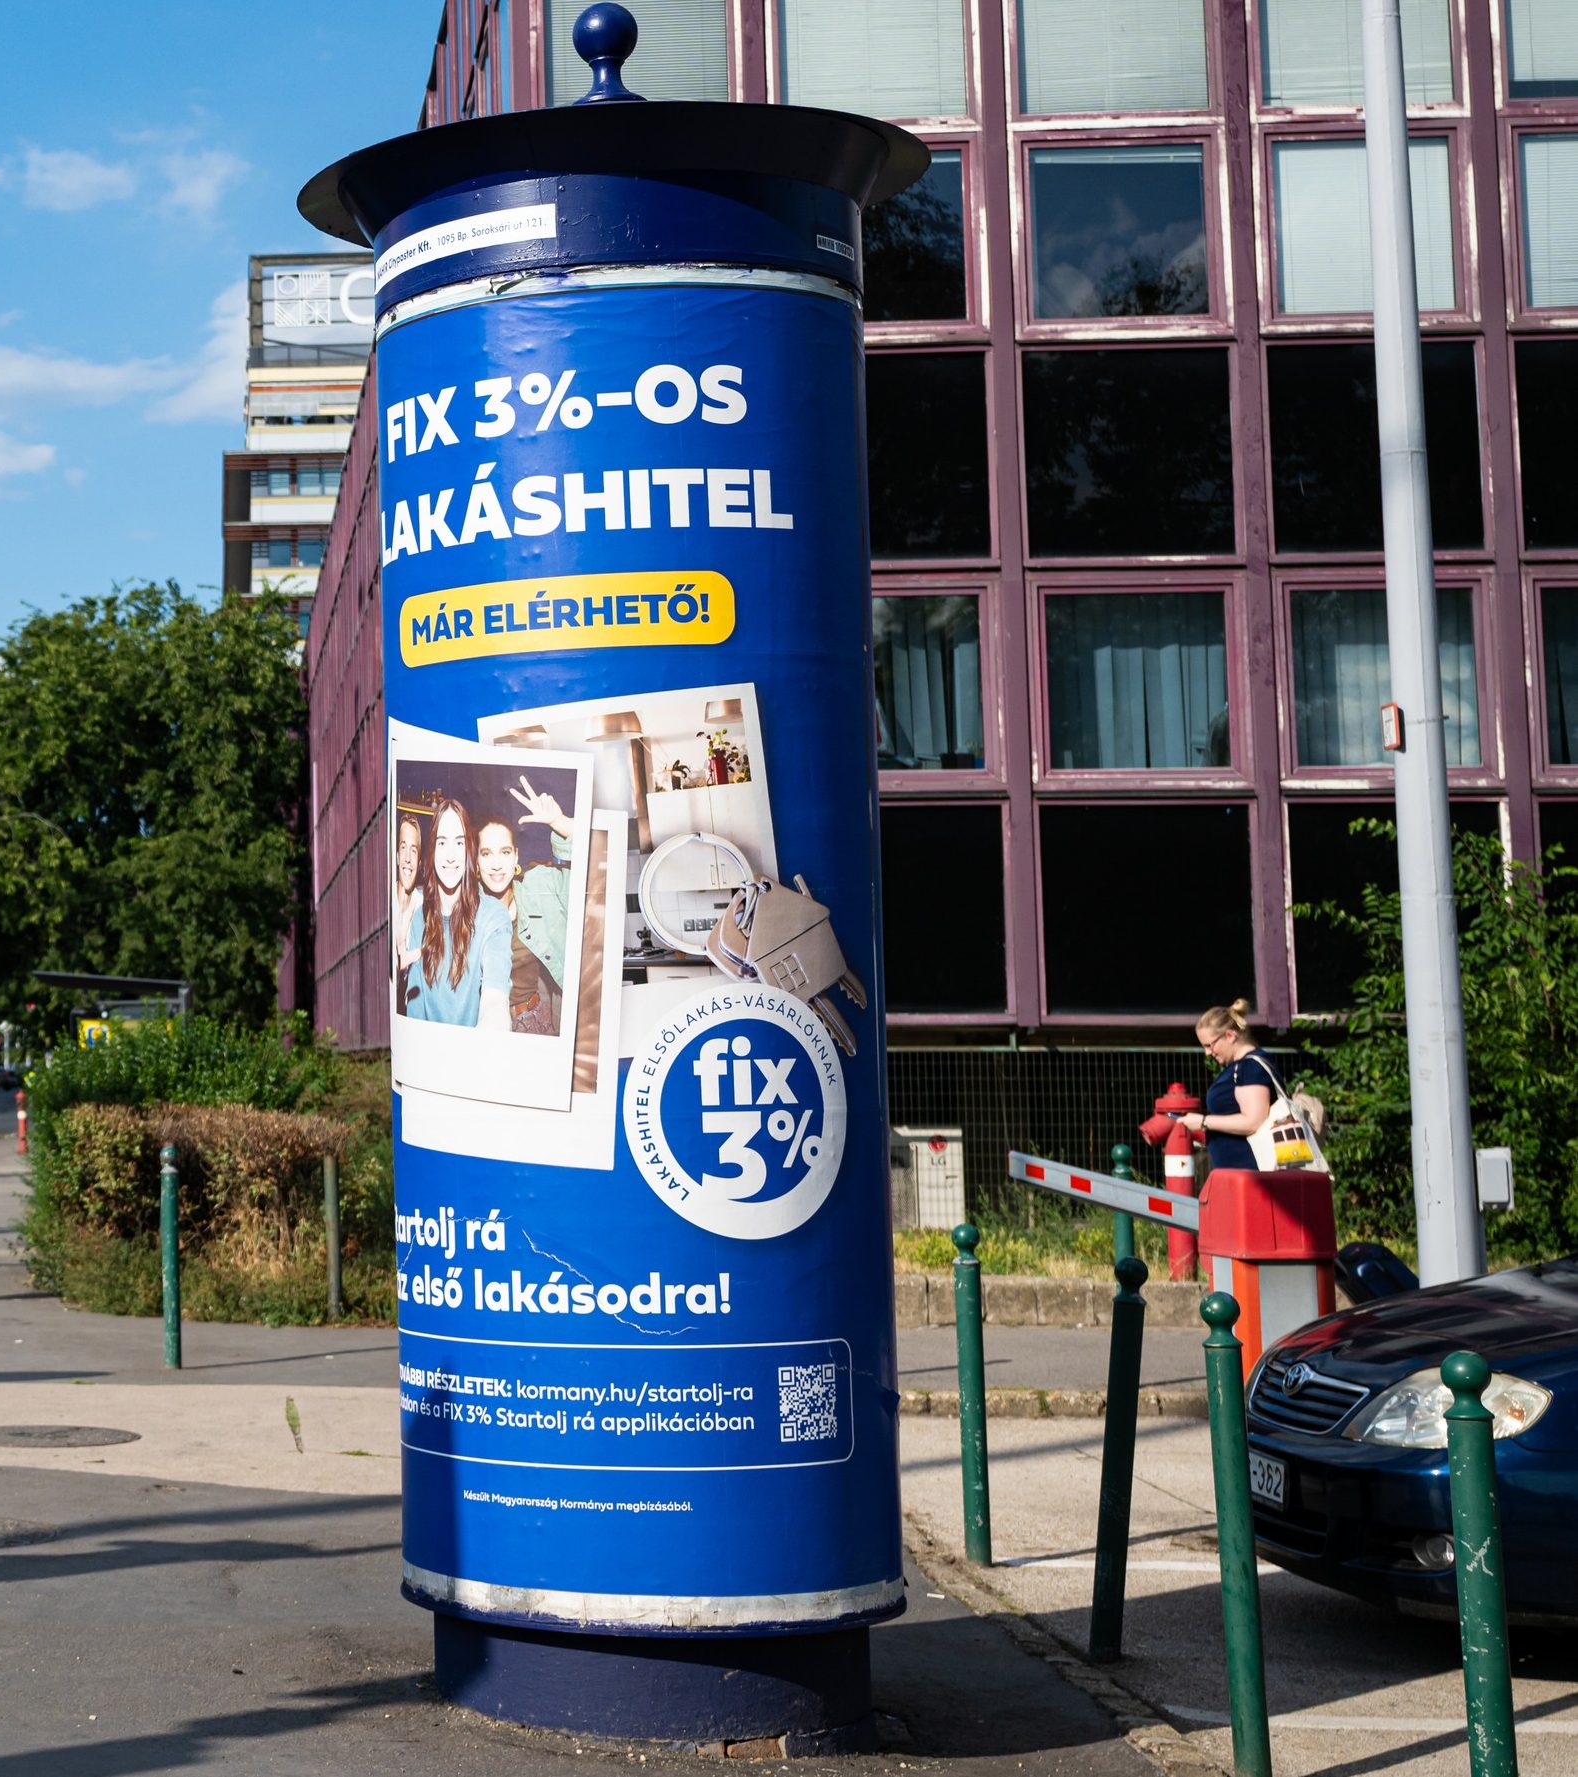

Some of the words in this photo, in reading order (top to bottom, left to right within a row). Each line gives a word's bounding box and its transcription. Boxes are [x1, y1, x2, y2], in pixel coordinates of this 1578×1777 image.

[418, 240, 432, 254] Kft.
[437, 233, 456, 247] 1095
[457, 231, 469, 244] Bp.
[387, 386, 460, 464] FIX
[380, 461, 794, 569] LAKÁSHITEL
[411, 602, 474, 646] MÁR
[484, 583, 710, 635] ELÉRHETŐ!
[642, 994, 837, 1086] ELSŐLAKÁS-VÁSÁRLÓKNAK
[692, 1035, 799, 1107] fix
[636, 1085, 690, 1202] LAKÁSHITEL
[701, 1109, 824, 1201] 3%
[466, 1208, 506, 1252] rá
[412, 1264, 464, 1309] első
[474, 1268, 733, 1316] lakásodra!
[420, 1397, 432, 1416] és
[432, 1404, 441, 1417] a
[443, 1401, 464, 1422] FIX
[466, 1405, 492, 1425] 3%
[495, 1406, 568, 1434] Startolj
[573, 1410, 595, 1431] rá
[601, 1410, 755, 1436] applikációban
[427, 1367, 512, 1398] RÉSZLETEK:
[516, 1379, 754, 1407] kormany.hu/startolj-ra
[463, 1489, 490, 1503] Készült
[491, 1493, 558, 1510] Magyarország
[560, 1498, 614, 1512] Kormánya
[616, 1500, 694, 1514] megbízásából.
